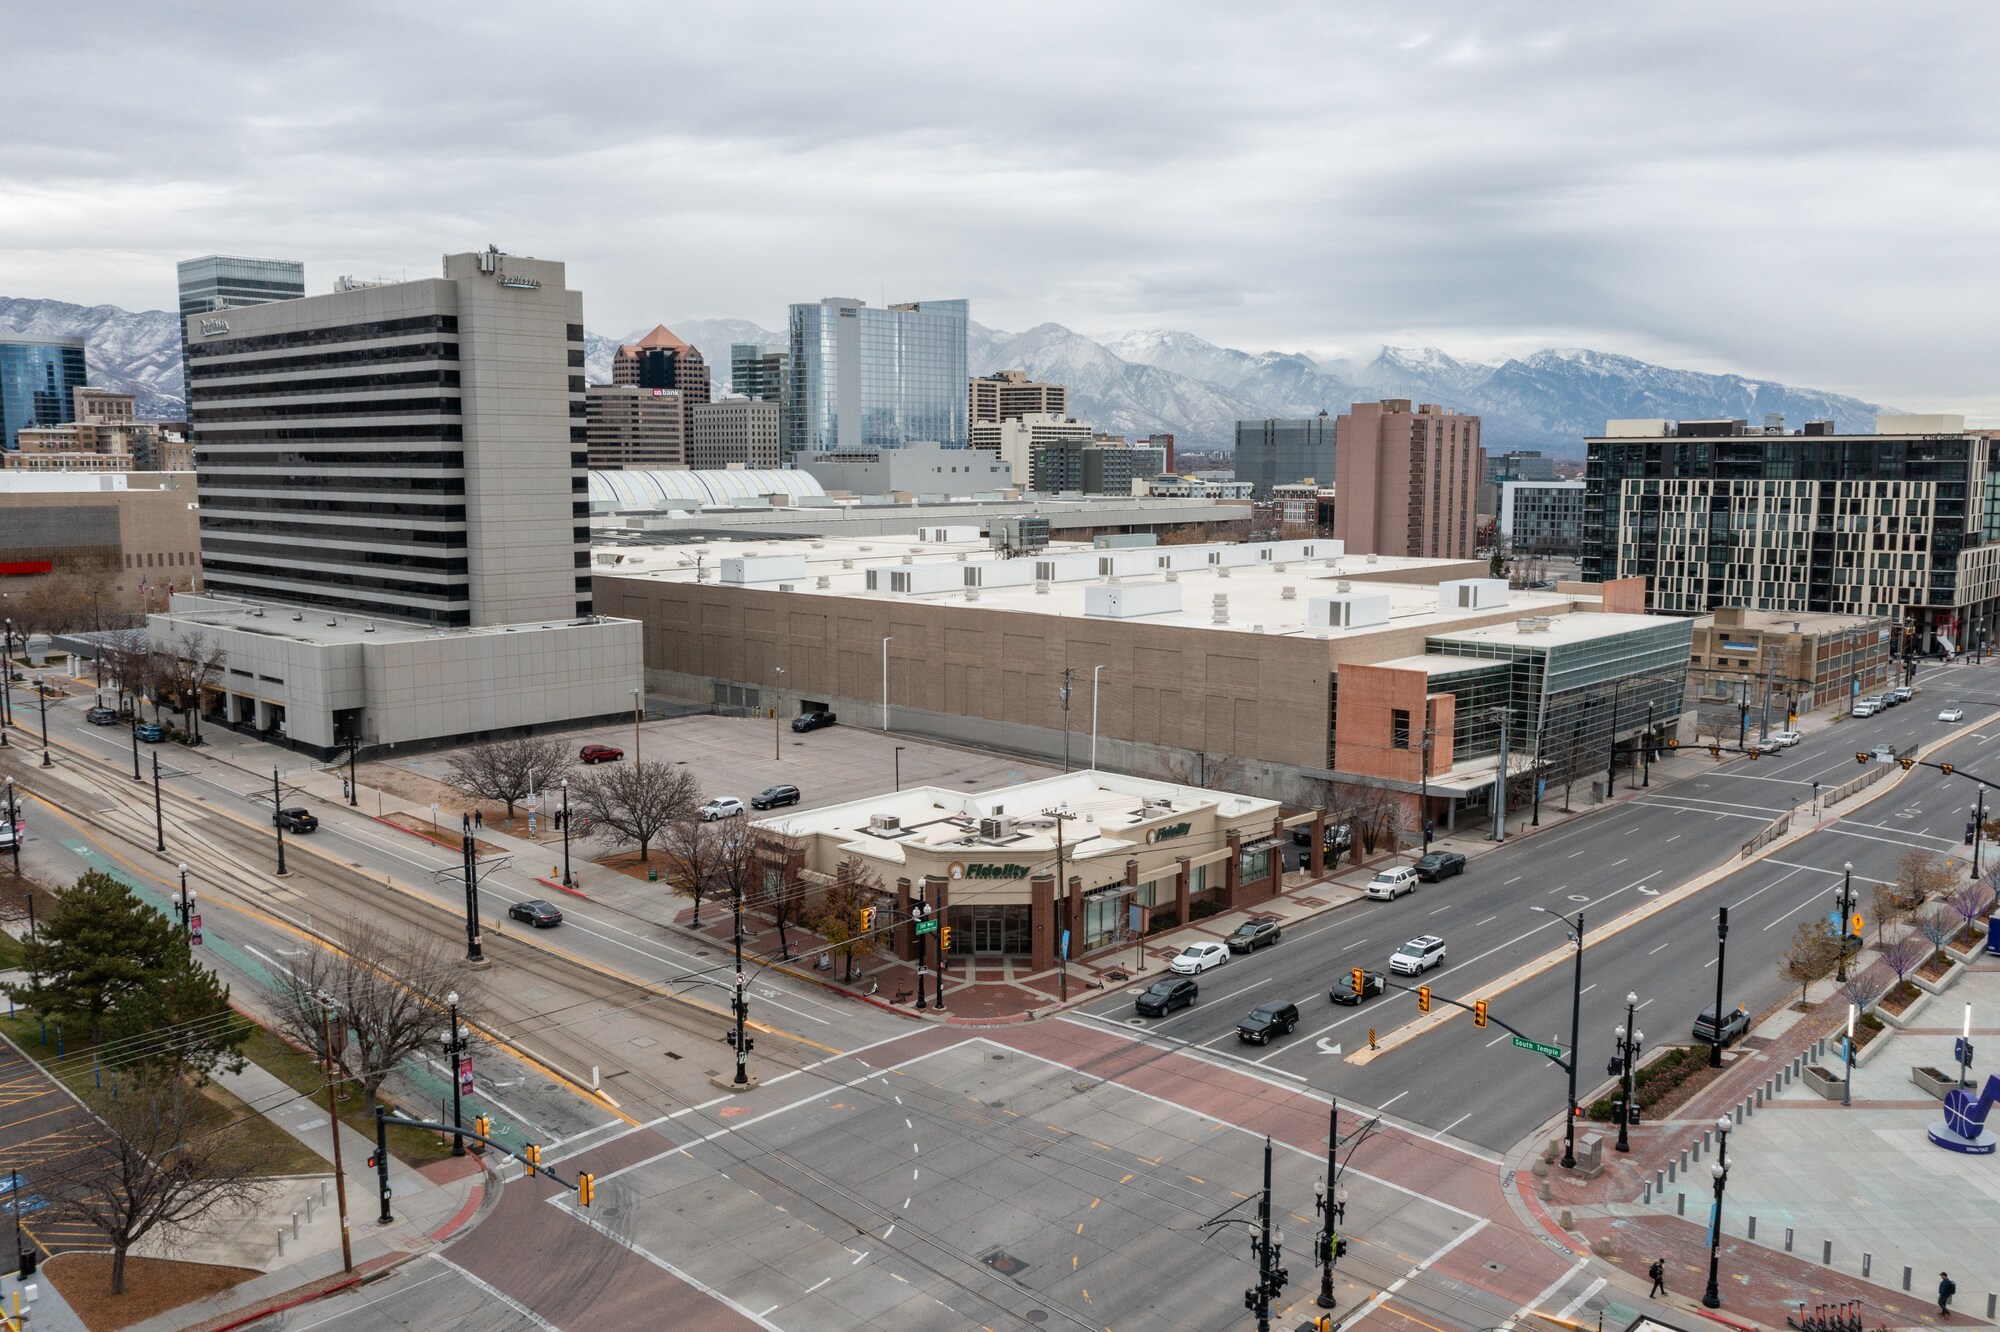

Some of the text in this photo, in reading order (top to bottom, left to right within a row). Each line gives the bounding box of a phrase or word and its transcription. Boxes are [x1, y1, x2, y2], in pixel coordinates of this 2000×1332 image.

[1157, 823, 1192, 841] Fidelity
[966, 864, 1031, 879] Fidelity
[1515, 1039, 1559, 1056] South Temple
